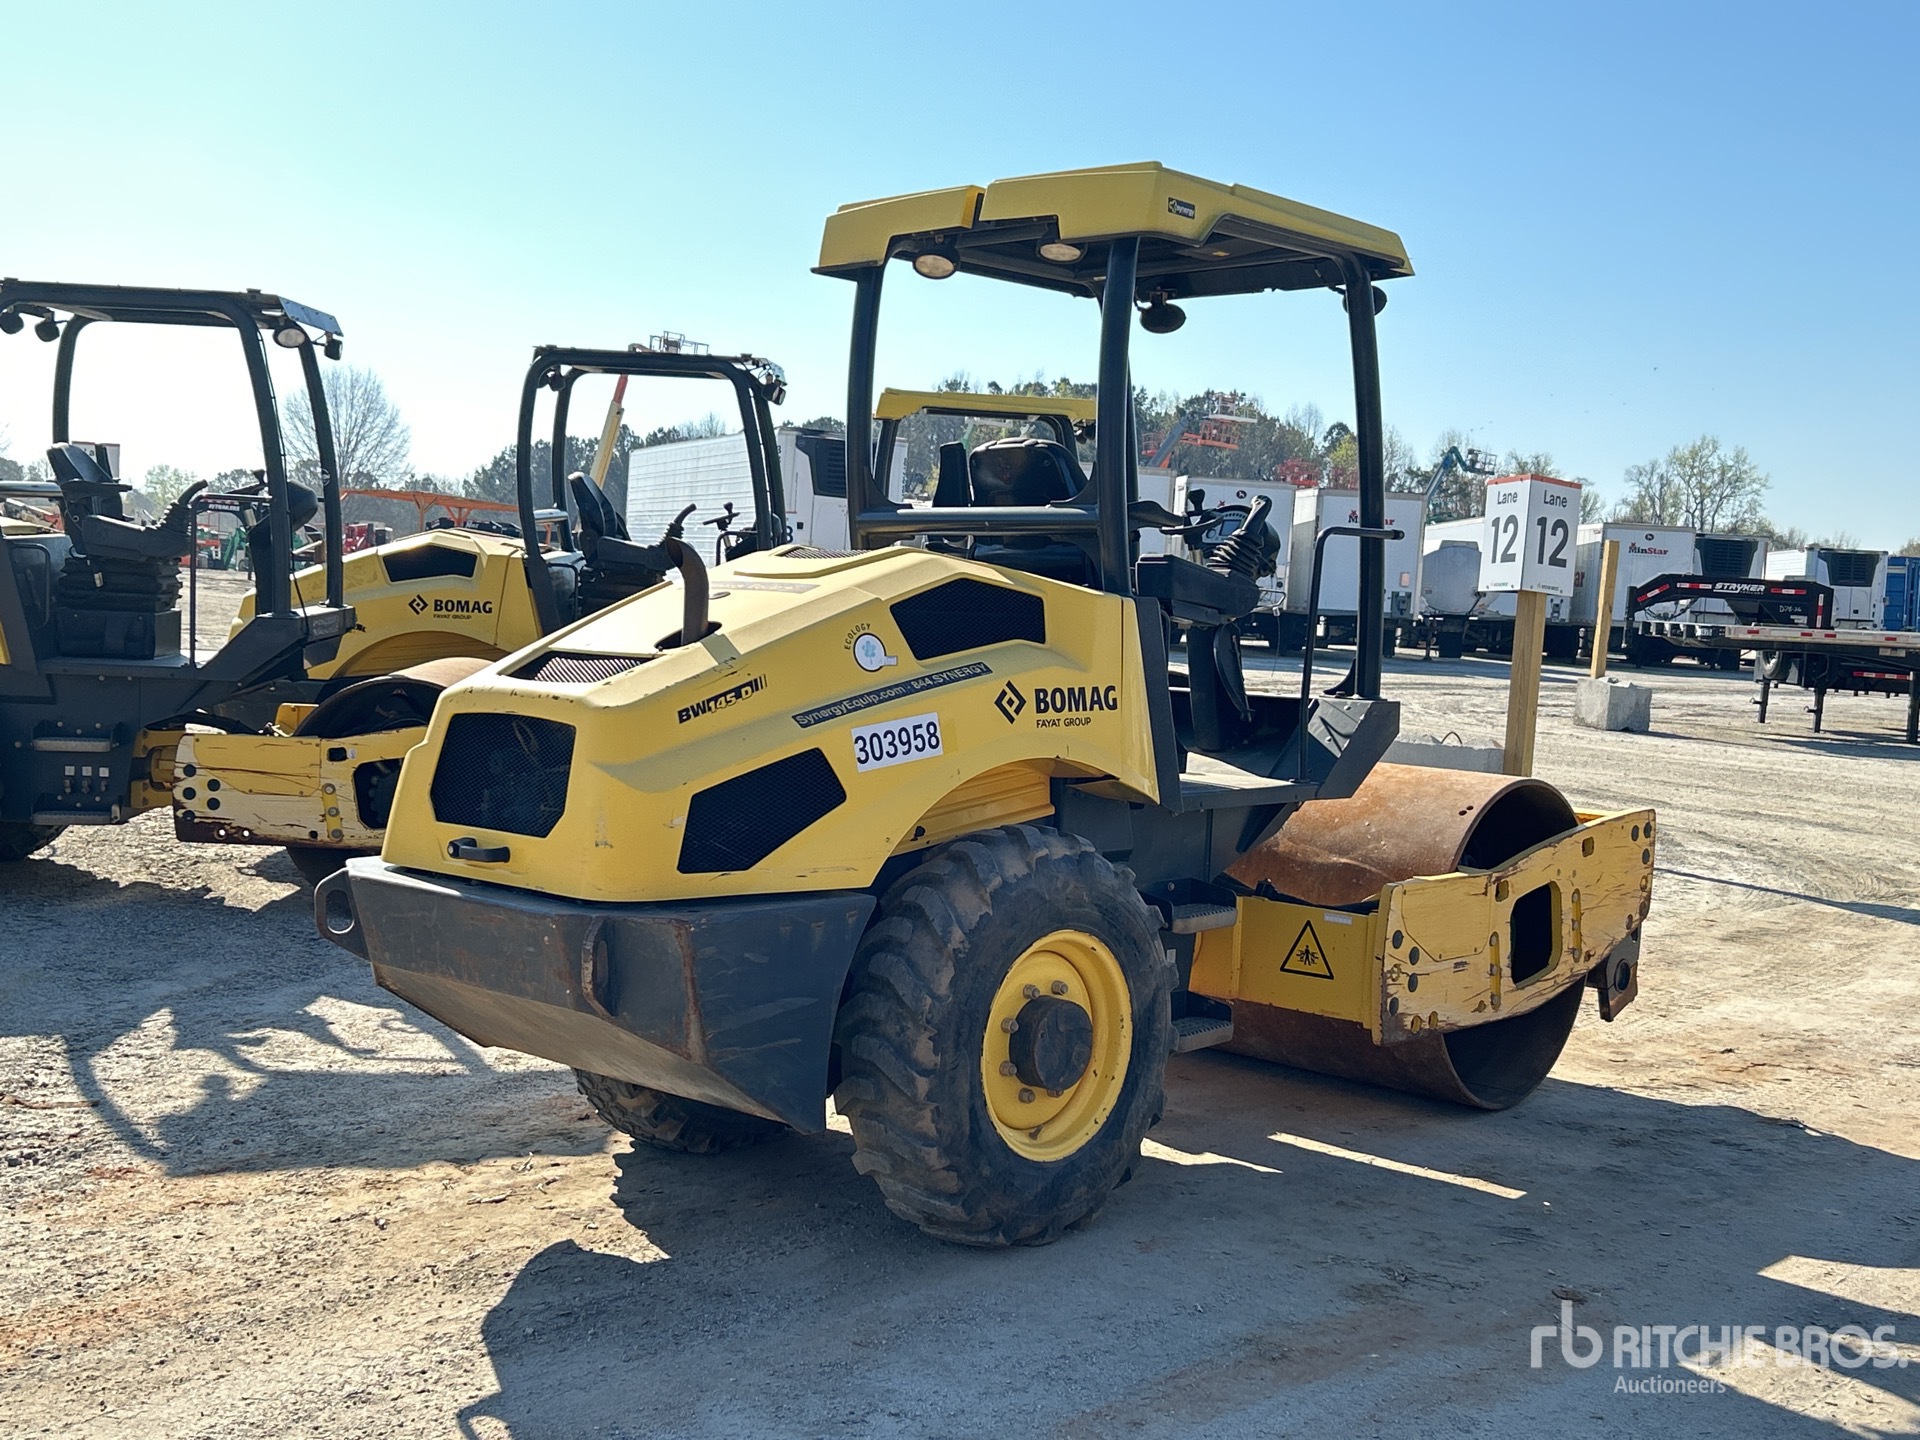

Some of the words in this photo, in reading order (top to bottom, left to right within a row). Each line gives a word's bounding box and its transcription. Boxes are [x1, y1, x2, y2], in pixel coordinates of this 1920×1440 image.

[1497, 490, 1518, 505] Lane
[1543, 490, 1568, 508] Lane
[1491, 514, 1519, 564] 12
[1536, 516, 1569, 568] 12
[1628, 544, 1669, 555] MinStar
[1713, 582, 1766, 594] STRYKER
[433, 599, 493, 614] BOMAG
[843, 622, 871, 651] ECOLOGY
[796, 684, 906, 726] SynergyEquip.com
[911, 662, 988, 690] 844.SYNERGY
[1034, 685, 1118, 714] BOMAG
[1036, 718, 1061, 729] FAYAT
[1063, 716, 1091, 728] GROUP
[853, 721, 940, 765] 303958
